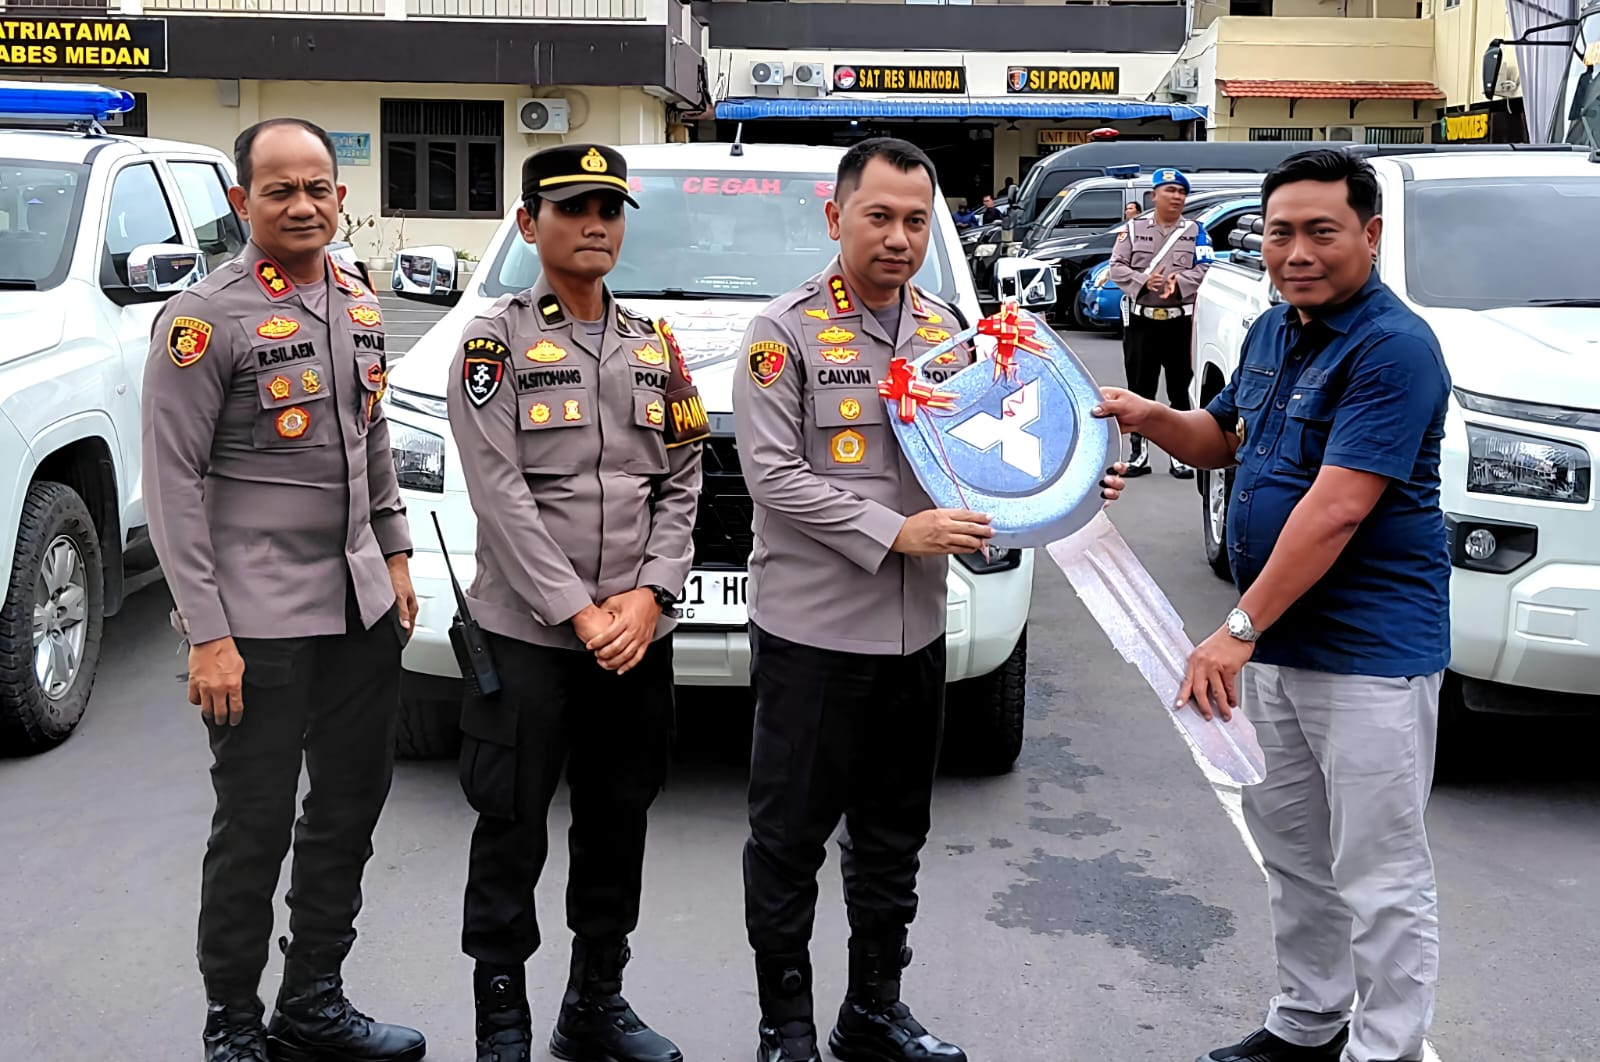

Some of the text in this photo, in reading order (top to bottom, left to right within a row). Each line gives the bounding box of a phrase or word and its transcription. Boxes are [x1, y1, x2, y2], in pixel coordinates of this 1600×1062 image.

[66, 46, 149, 65] MEDAN
[859, 68, 960, 90] SAT RES NARKOBA
[1029, 70, 1115, 91] SI PROPAM
[683, 176, 781, 196] CEGAH
[258, 342, 316, 367] R.SILAEN
[468, 339, 506, 354] SPKT
